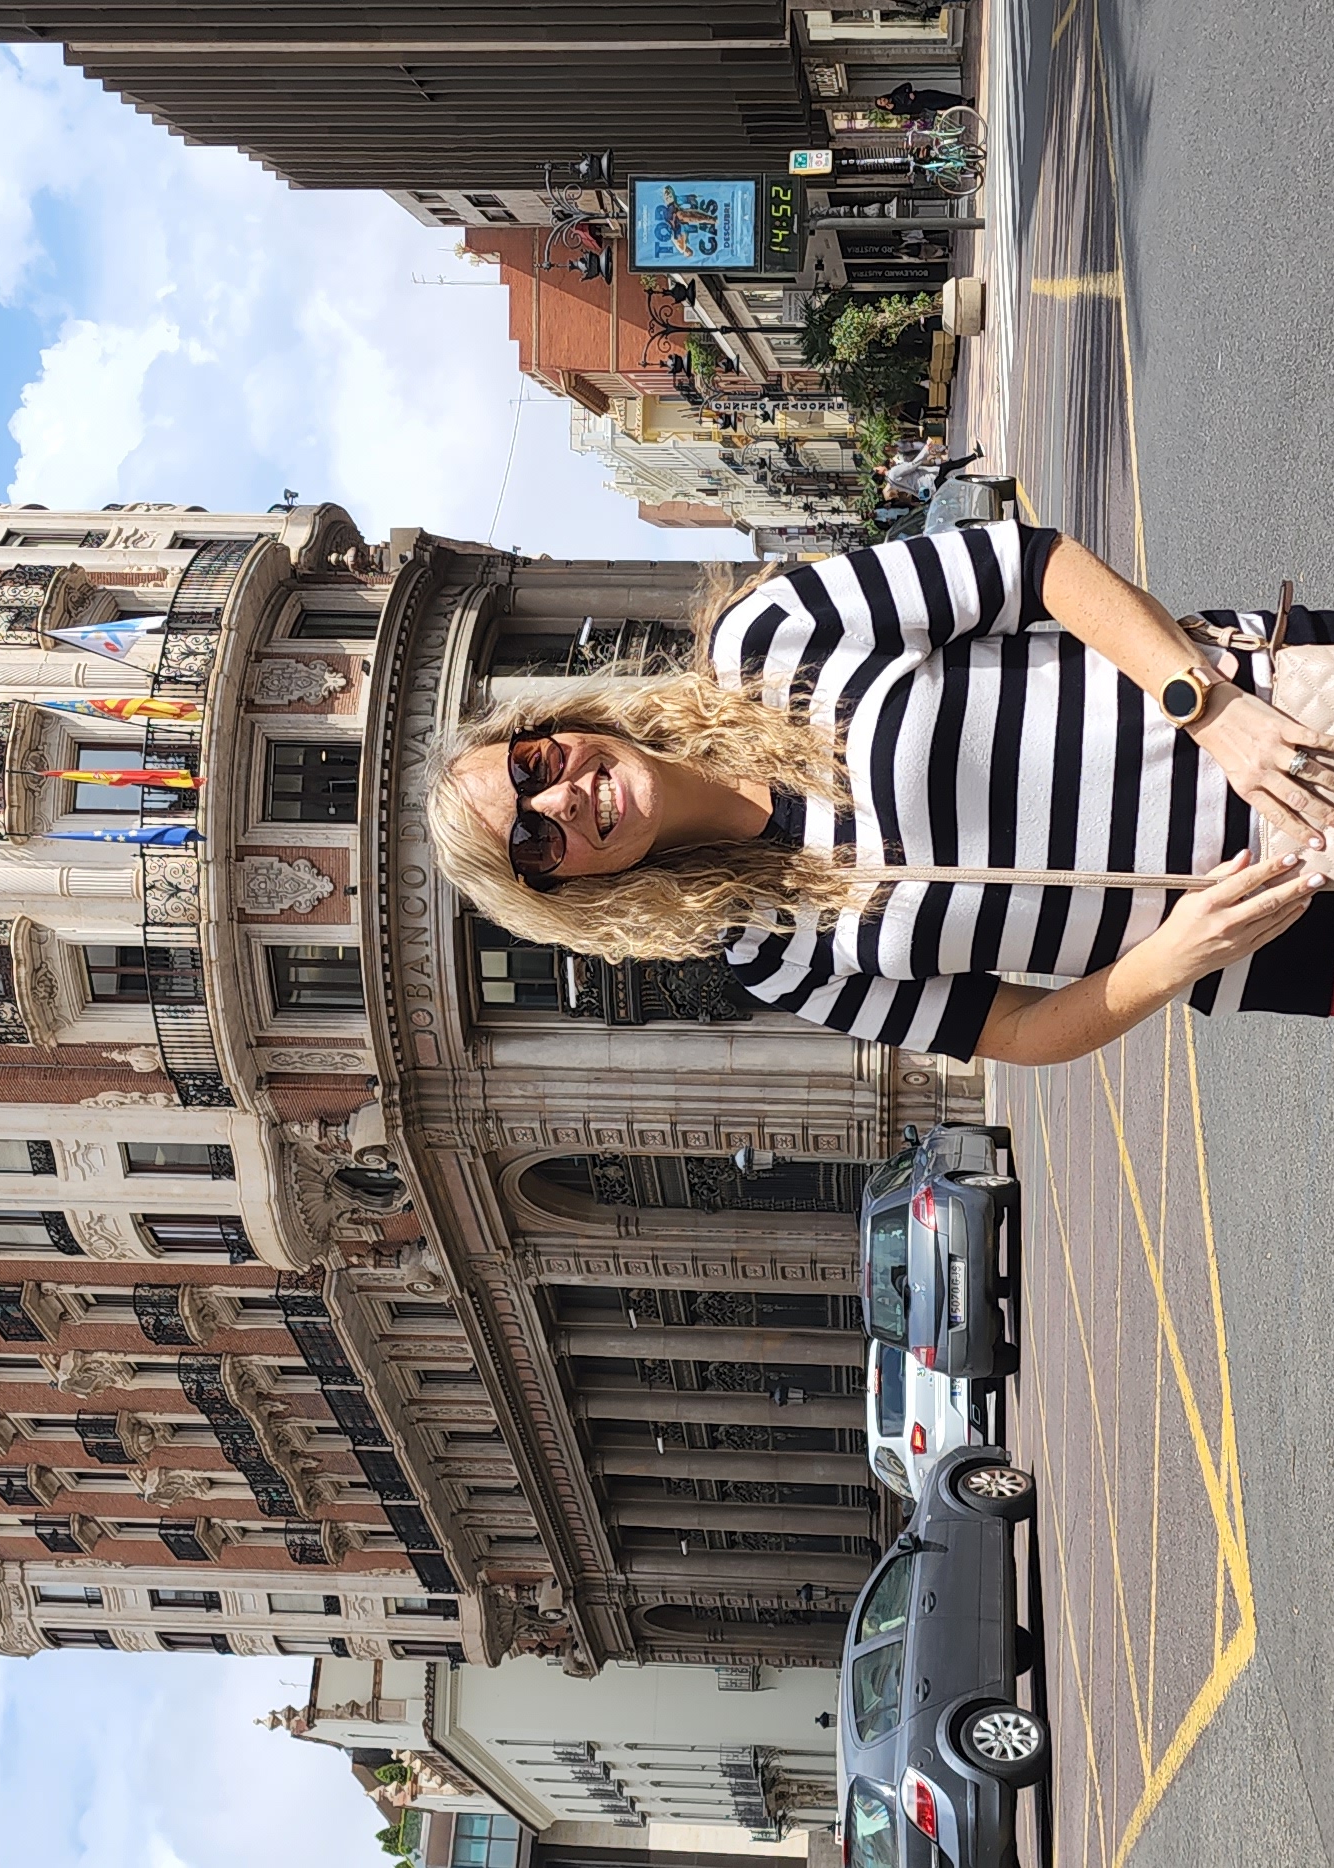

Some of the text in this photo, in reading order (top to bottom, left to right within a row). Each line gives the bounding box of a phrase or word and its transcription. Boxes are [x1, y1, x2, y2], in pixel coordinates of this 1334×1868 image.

[699, 199, 718, 256] GAS
[723, 202, 731, 248] DESCUBRE
[770, 186, 791, 253] 14:52
[846, 245, 880, 254] AUSTRIA
[851, 269, 929, 278] BOULEVARD AUSTRIA
[714, 402, 767, 411] CENTRO
[400, 609, 454, 1003] BANCO DE VALENCIA
